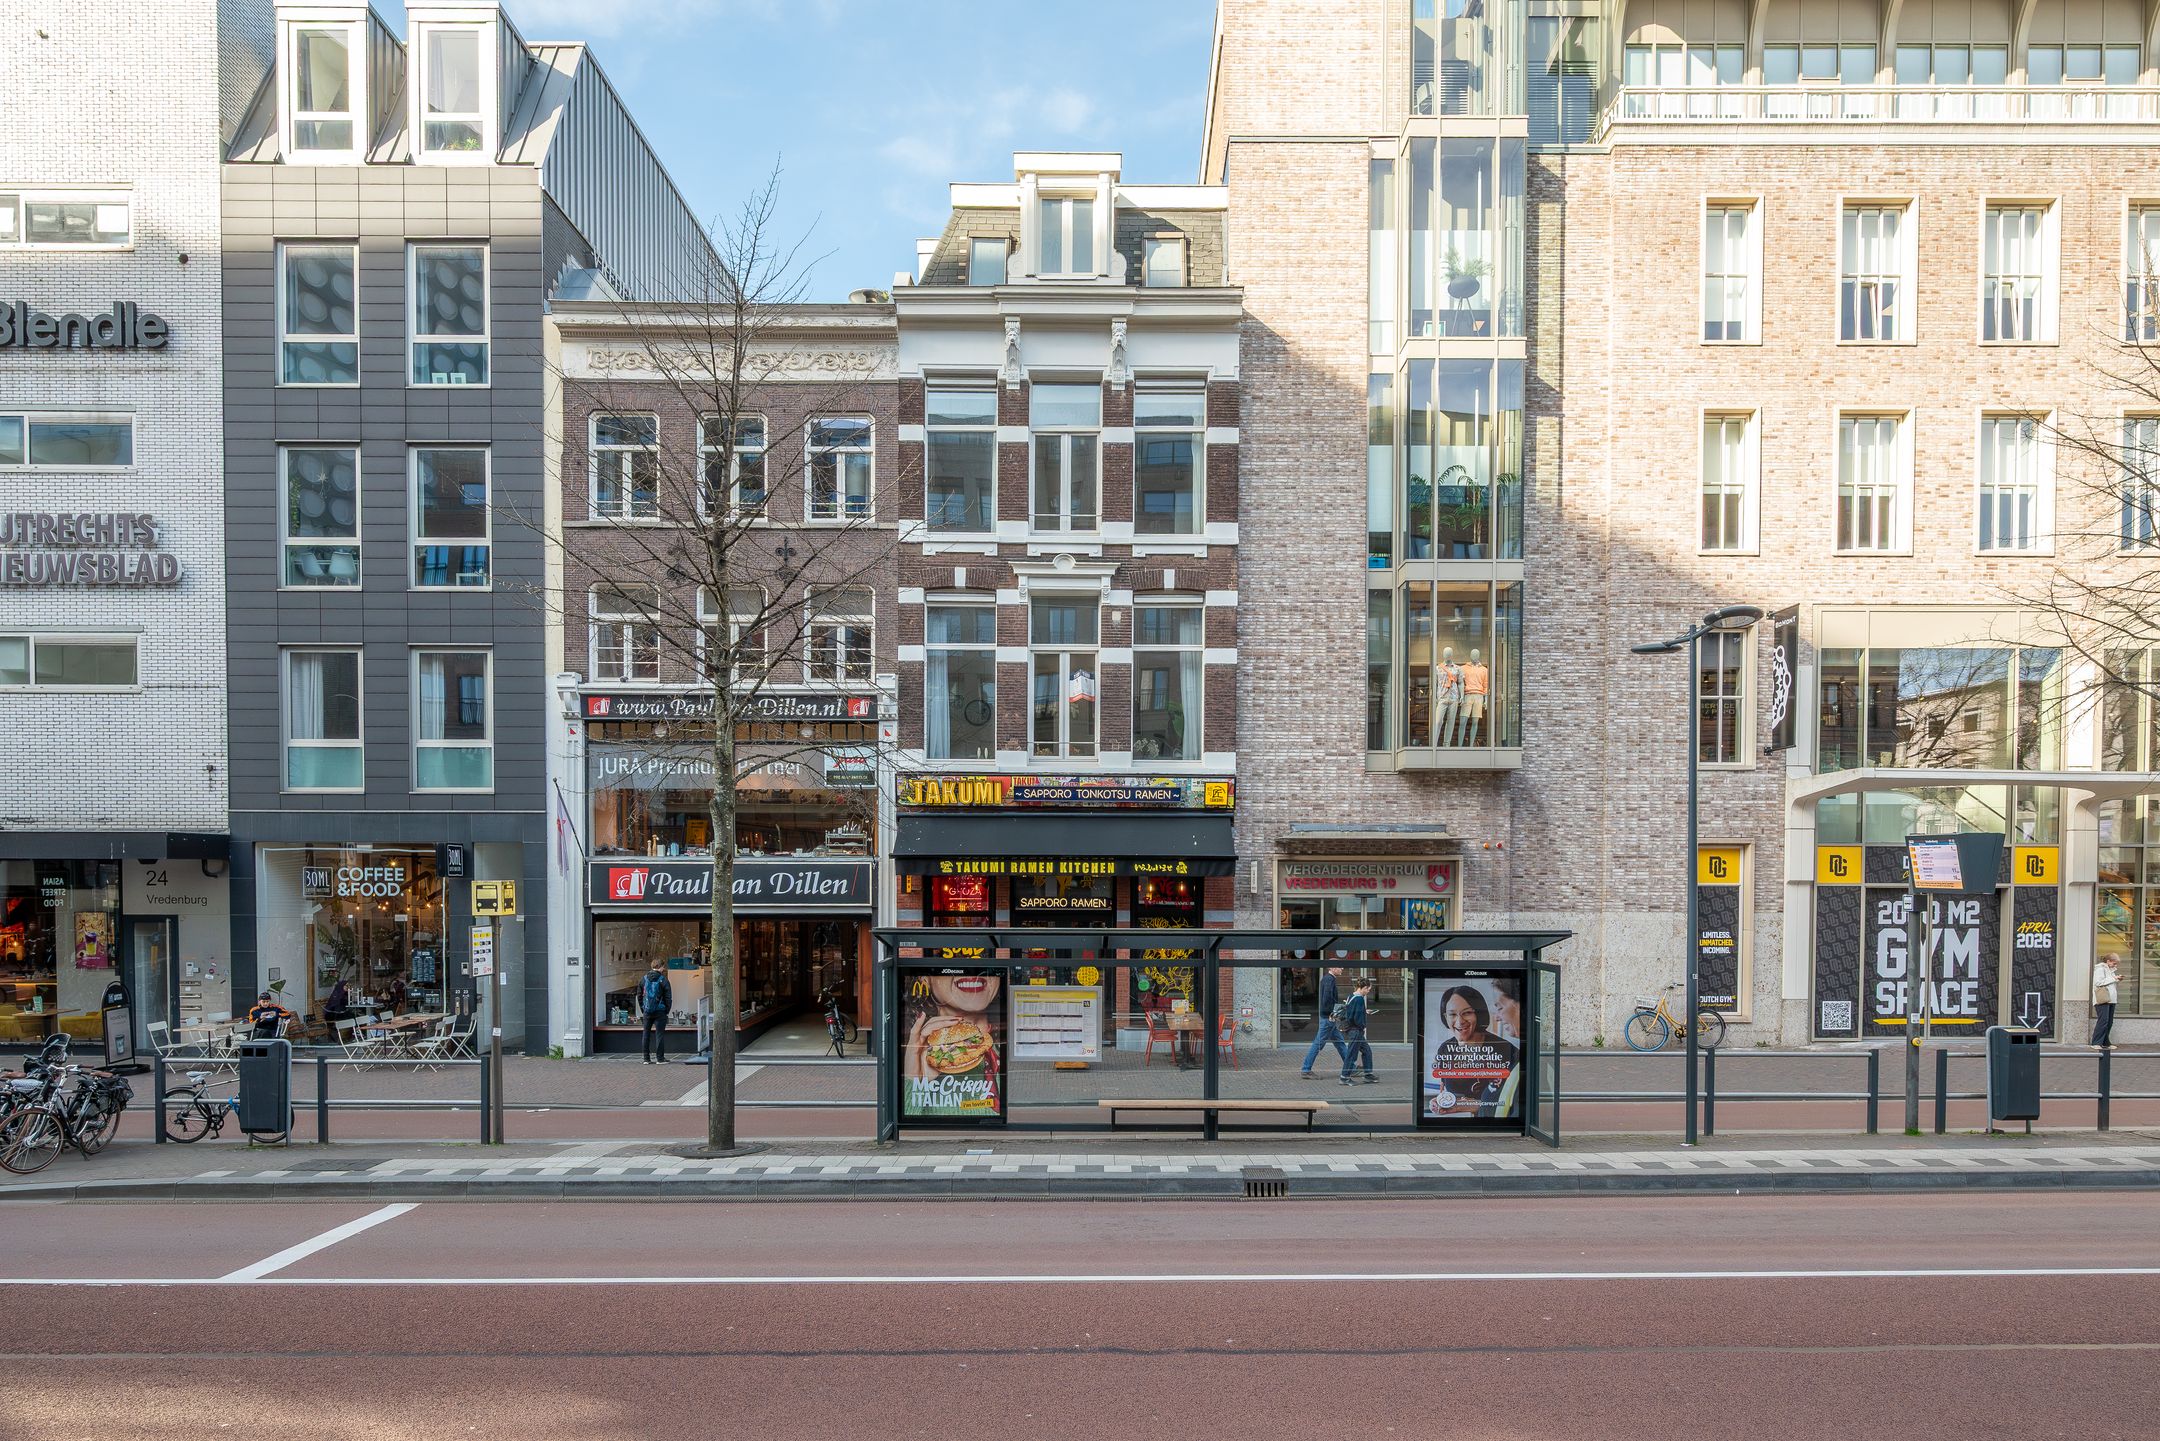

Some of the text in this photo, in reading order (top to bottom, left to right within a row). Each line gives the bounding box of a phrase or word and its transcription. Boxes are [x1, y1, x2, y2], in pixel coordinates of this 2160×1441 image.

[597, 757, 643, 779] JURA
[911, 779, 1004, 805] TAKUMI
[1023, 788, 1171, 799] SAPPORO TONKOTSU RAMEN
[337, 867, 405, 882] COFFEE
[955, 861, 1116, 873] TAKUMI RAMEN KITCHEN
[1285, 864, 1425, 875] VERGADERCENTRUM
[146, 870, 168, 886] 24
[305, 870, 330, 887] 30ML
[650, 870, 849, 895] Paul an Dillen
[1285, 877, 1397, 890] VREDENBURG 19
[337, 882, 405, 897] &FOOD.
[146, 895, 208, 906] Vredenburg
[1020, 897, 1107, 908] SAPPORO RAMEN
[1877, 900, 1981, 925] 200 M2
[2016, 922, 2053, 933] APRIL
[2016, 933, 2052, 949] 2026
[1436, 1052, 1503, 1062] een zorglocatie
[1446, 1044, 1494, 1055] Werken op
[1432, 1061, 1511, 1070] of bij cliënten thuis?
[912, 1075, 995, 1101] McCrispy
[911, 1092, 963, 1107] ITALIAN
